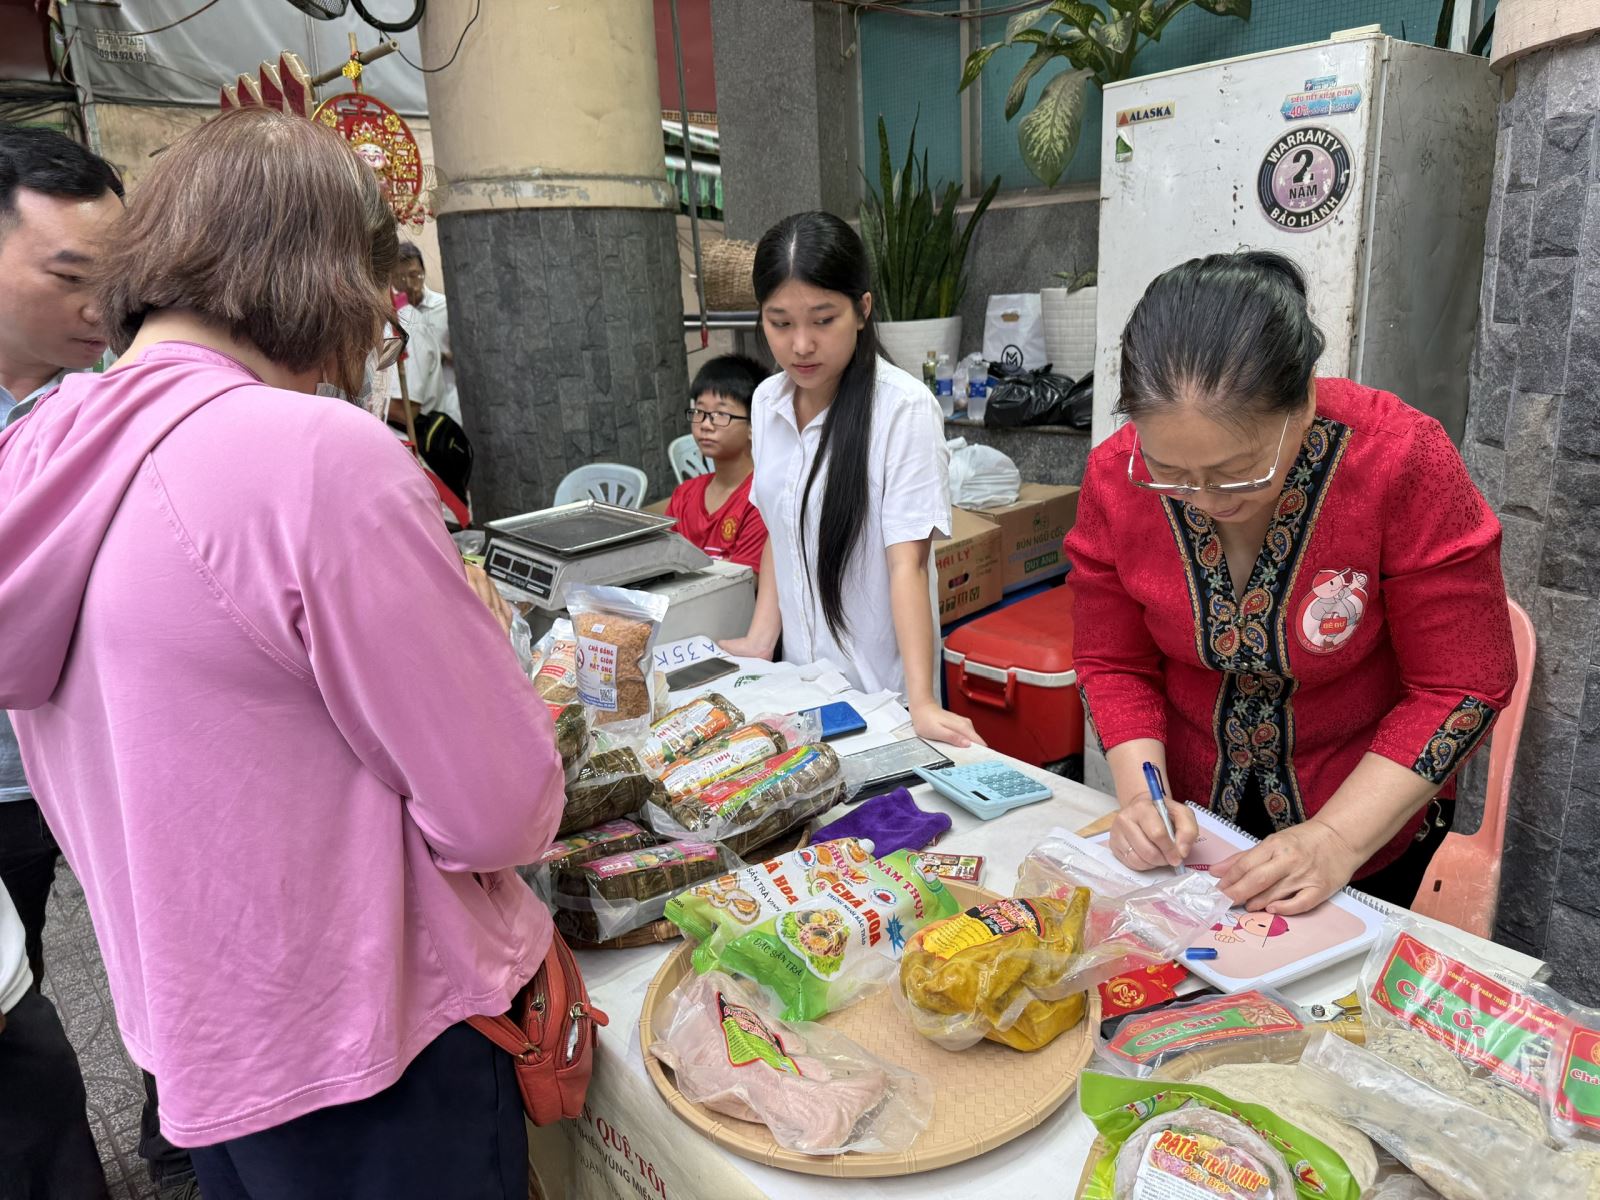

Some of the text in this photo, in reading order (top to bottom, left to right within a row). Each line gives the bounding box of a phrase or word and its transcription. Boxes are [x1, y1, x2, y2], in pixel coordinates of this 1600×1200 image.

[1129, 105, 1171, 121] ALASKA
[1268, 130, 1341, 163] WARRANTY
[1293, 149, 1315, 184] 2
[1270, 196, 1339, 226] BẢO HÀNH
[746, 867, 759, 883] SẢN
[772, 874, 799, 906] HOA
[831, 881, 881, 947] CHẢ HOA
[769, 948, 787, 963] SẢN
[1397, 979, 1488, 1040] Chả Ốc
[596, 1117, 634, 1164] QUÊ
[635, 1152, 667, 1200] TÔI
